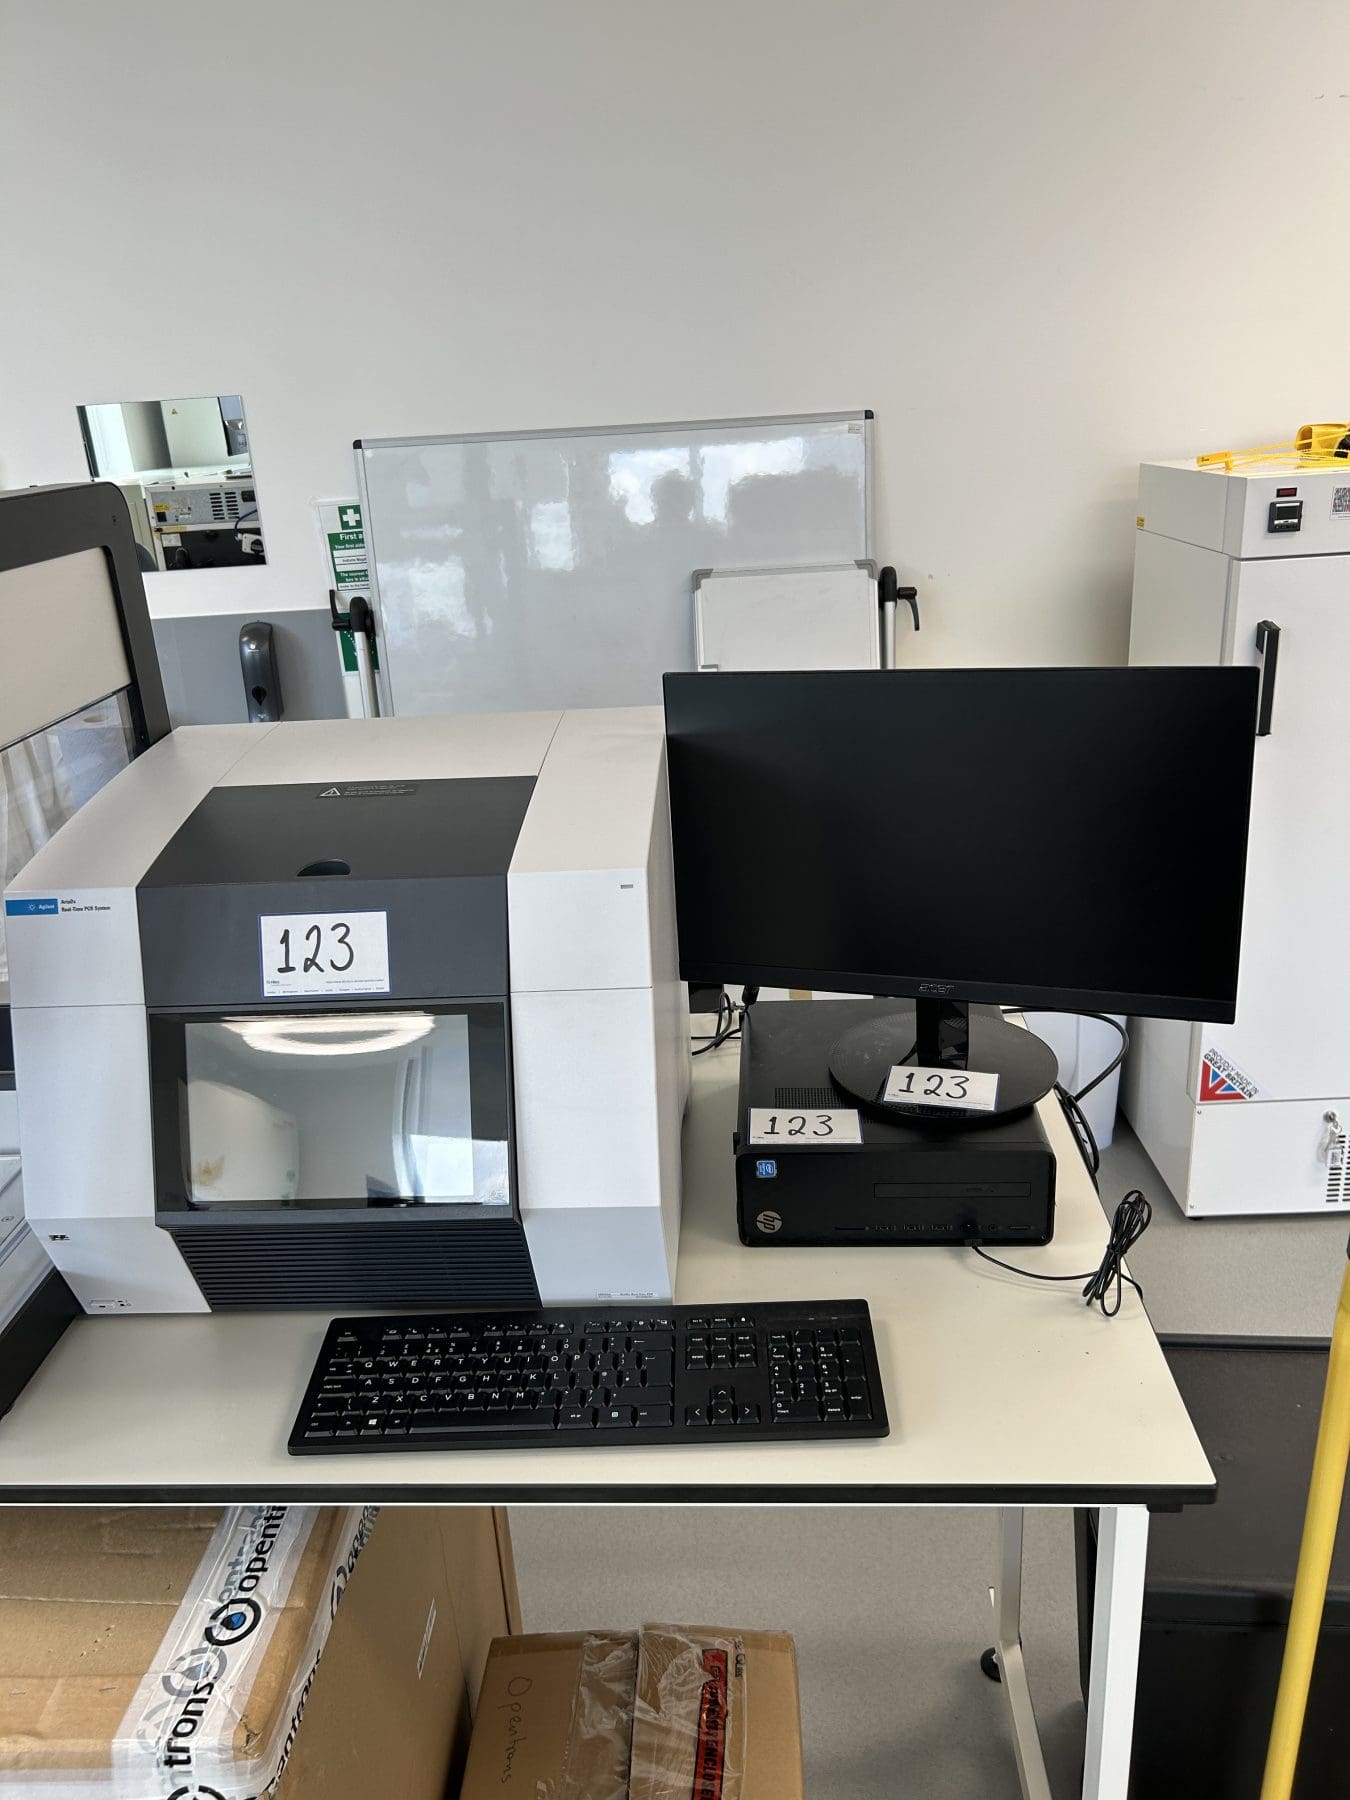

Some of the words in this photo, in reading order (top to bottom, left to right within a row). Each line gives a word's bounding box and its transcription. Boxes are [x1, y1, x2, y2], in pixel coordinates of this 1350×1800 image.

[340, 533, 357, 541] First
[277, 922, 354, 974] 123
[898, 1072, 970, 1099] 123
[1203, 1053, 1226, 1073] GREAT
[1225, 1071, 1253, 1098] BRITAIN
[763, 1114, 834, 1136] 123
[497, 1675, 533, 1785] Opentrons
